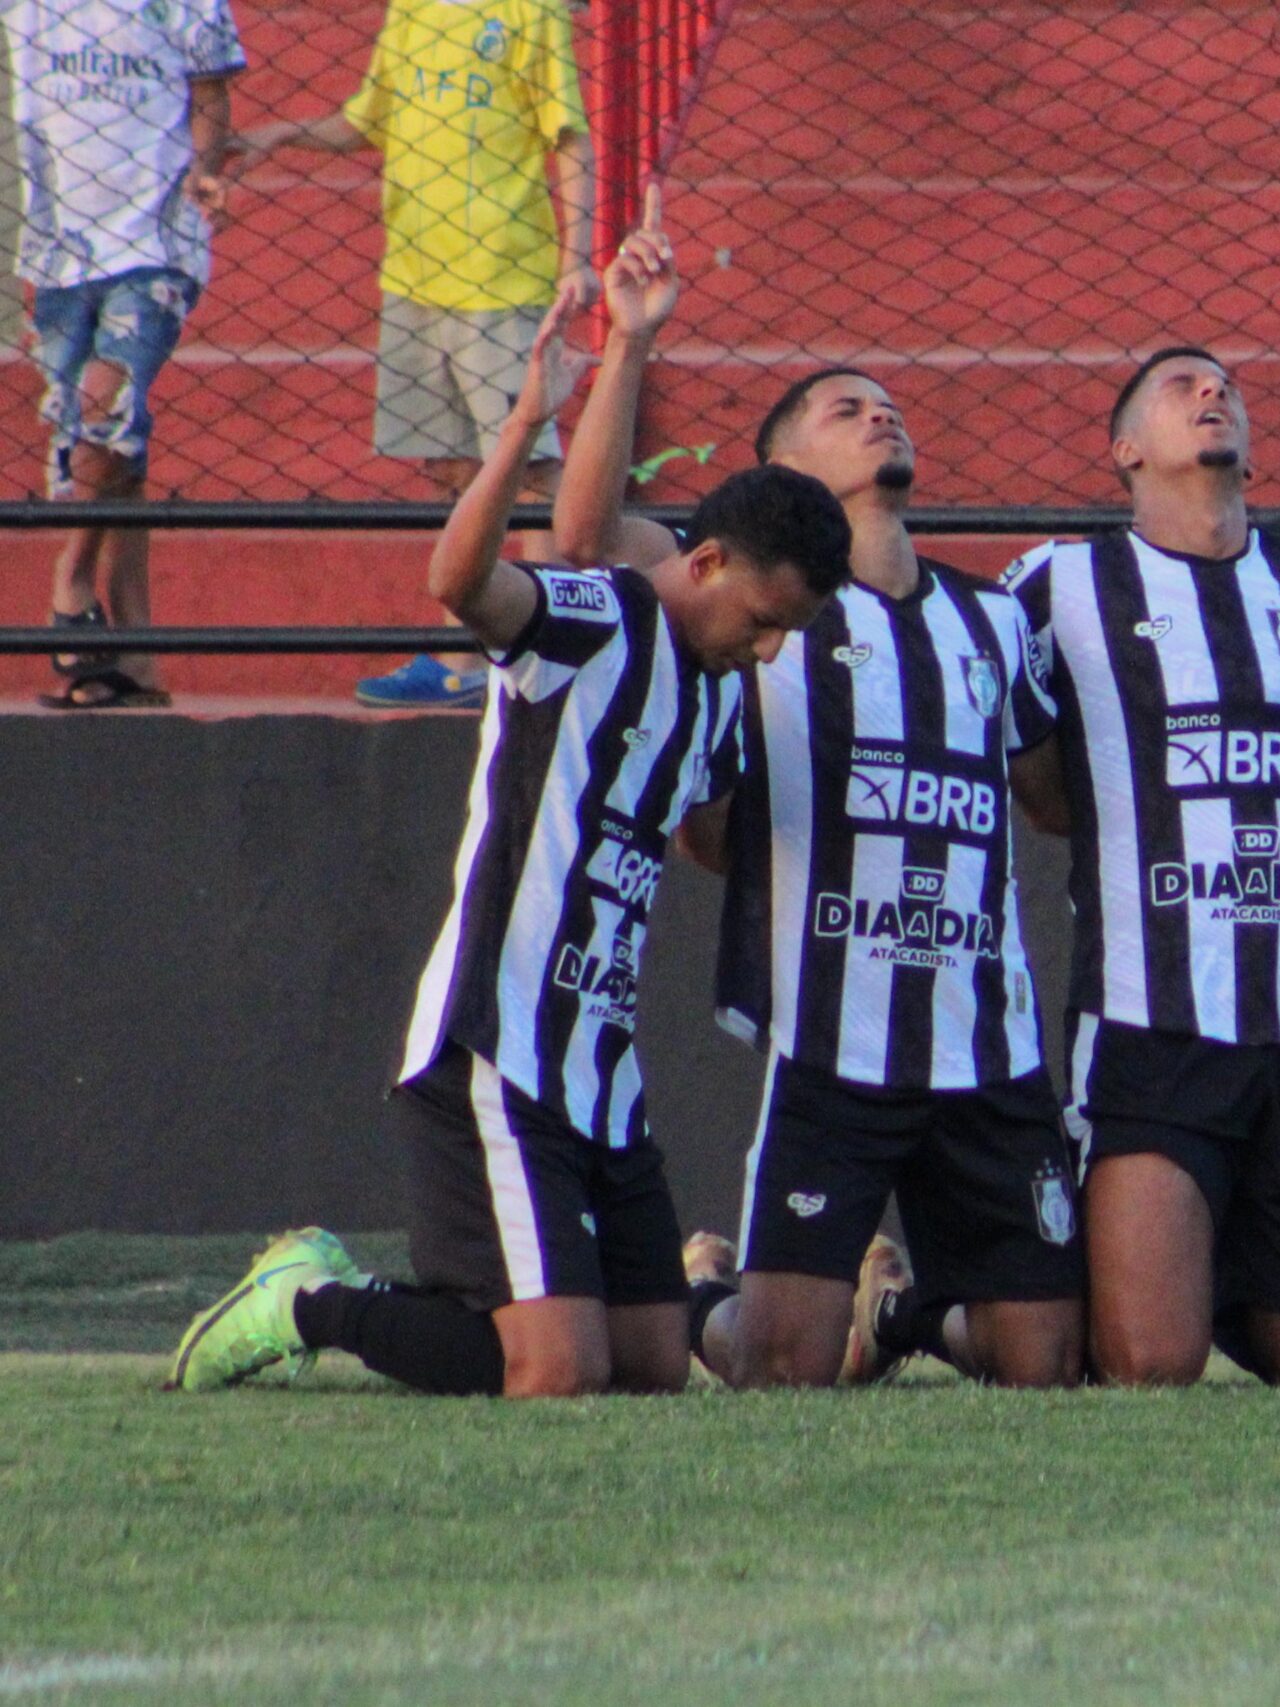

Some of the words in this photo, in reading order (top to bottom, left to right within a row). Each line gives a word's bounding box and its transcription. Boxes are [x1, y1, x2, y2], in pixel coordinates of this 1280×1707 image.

[1166, 713, 1221, 731] banco
[851, 746, 905, 763] banco
[904, 769, 996, 835] BRB
[869, 947, 959, 969] ATACADISTA
